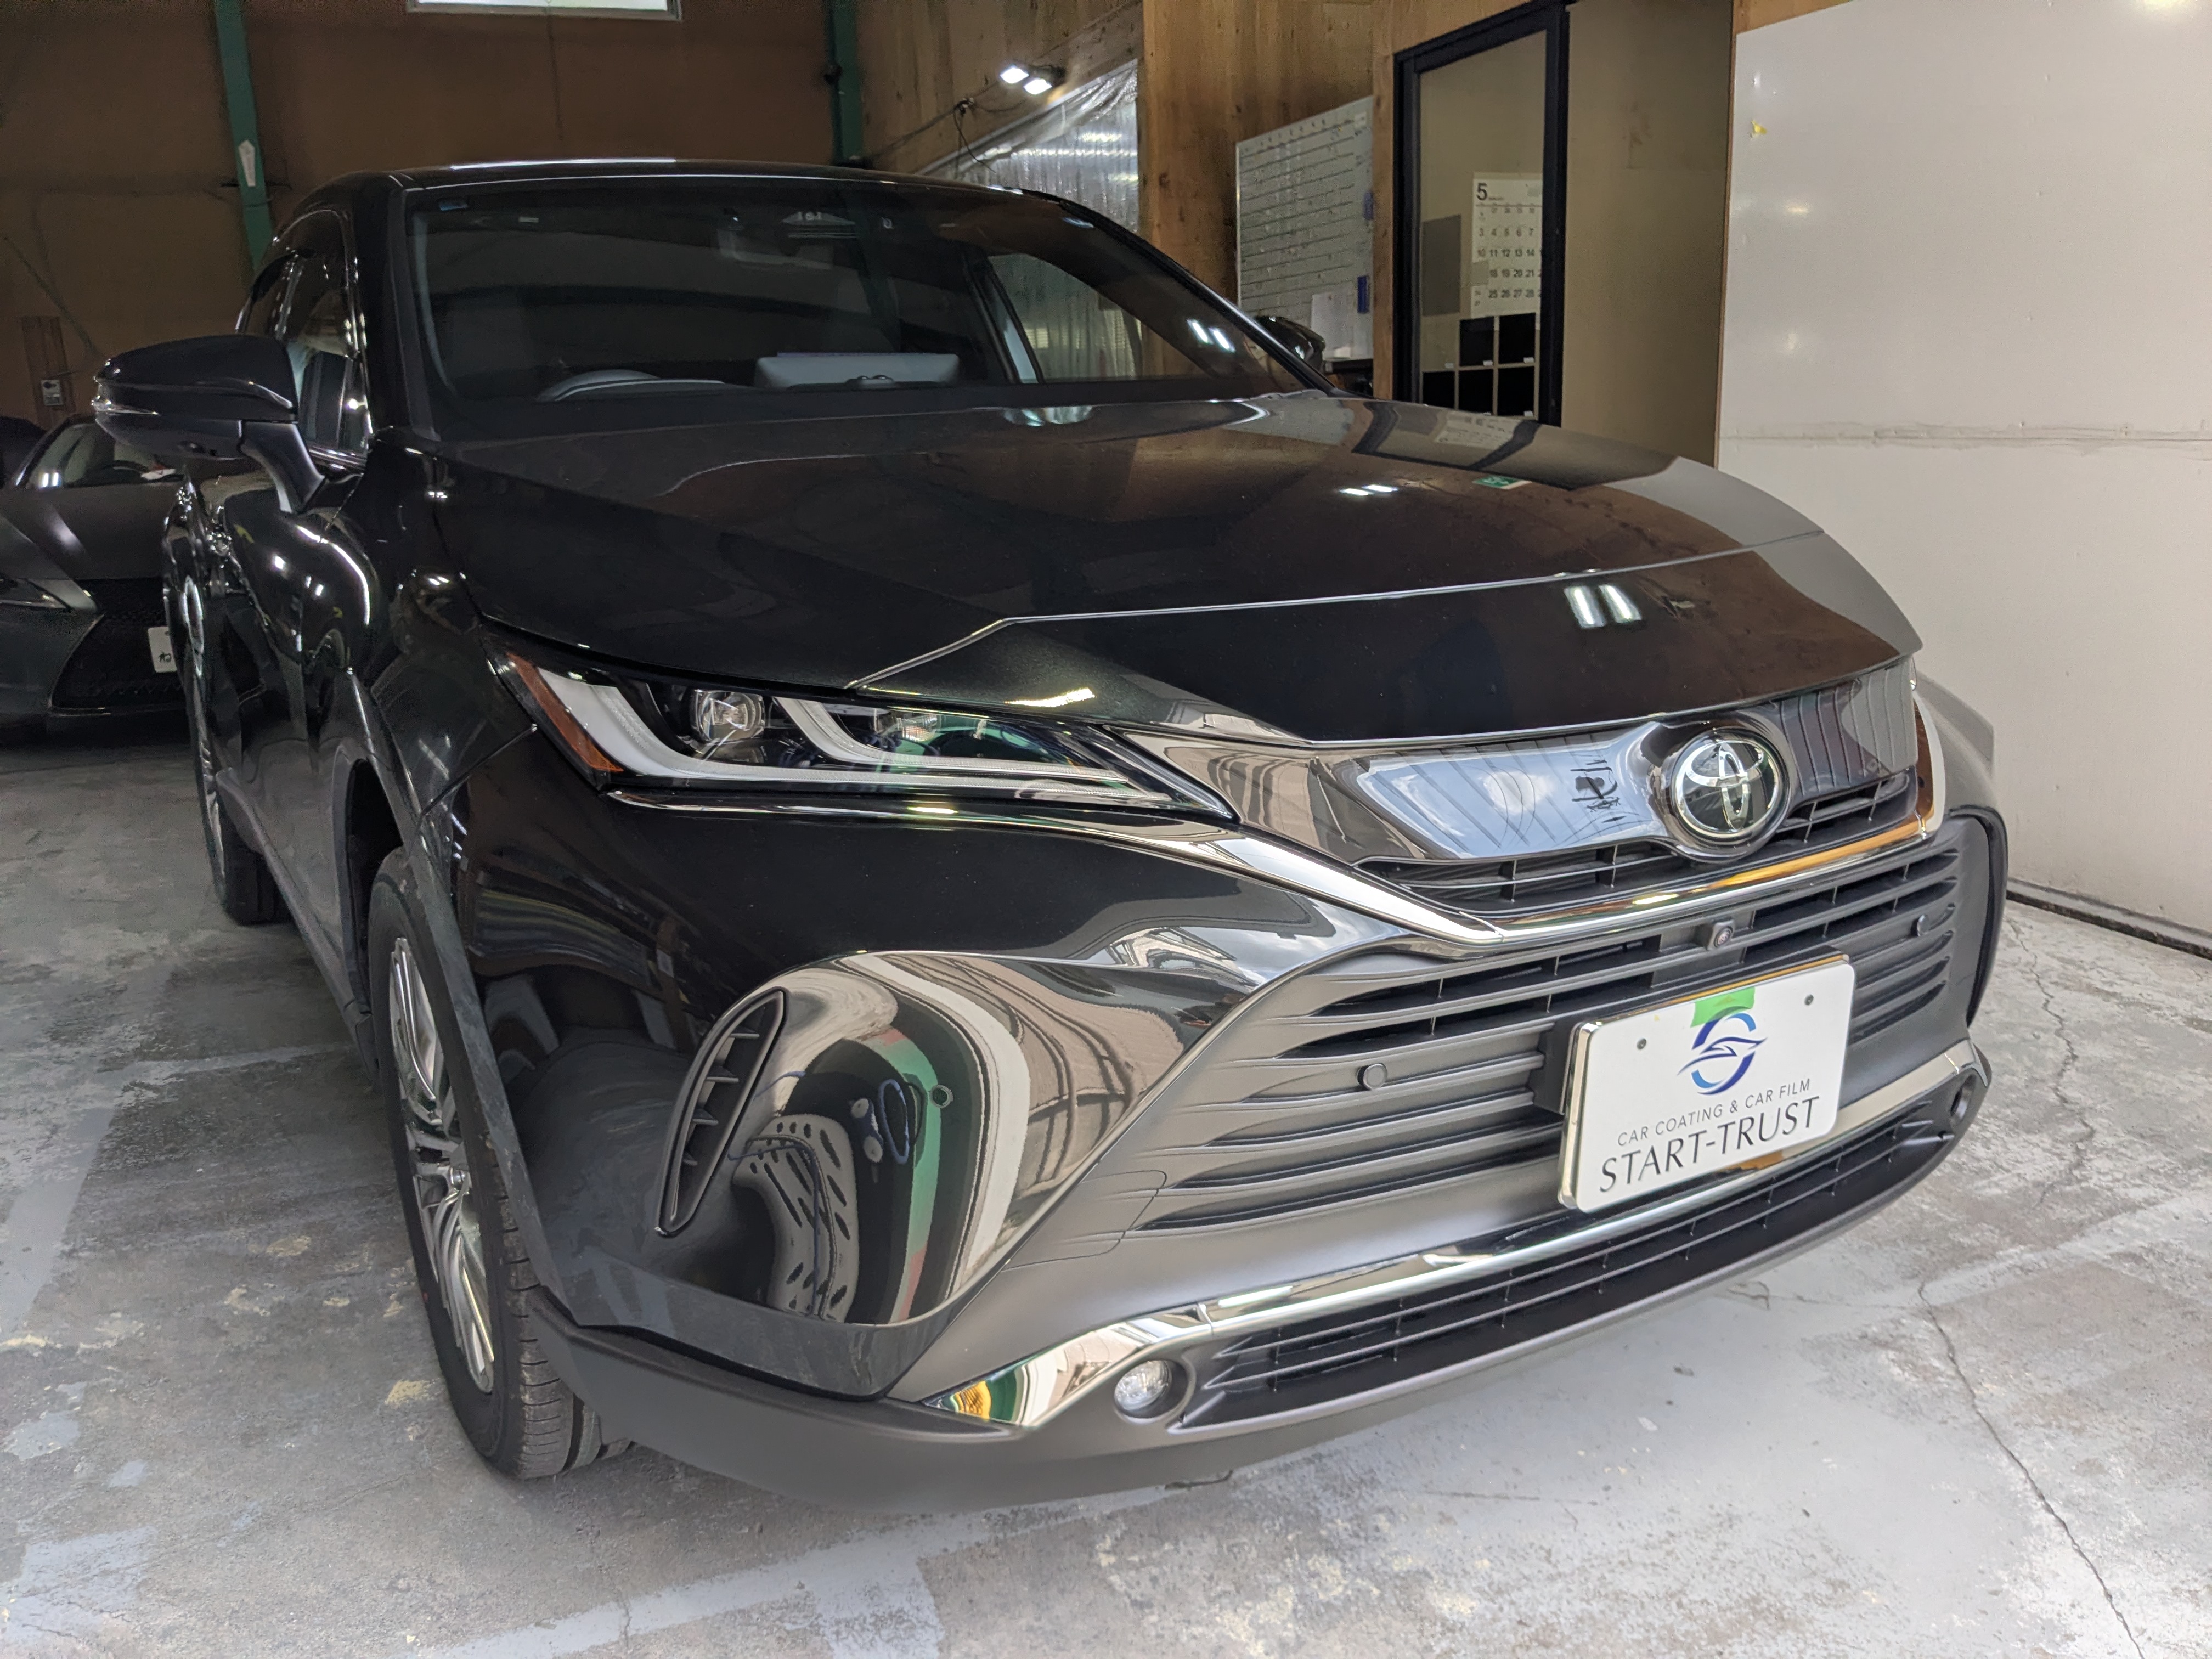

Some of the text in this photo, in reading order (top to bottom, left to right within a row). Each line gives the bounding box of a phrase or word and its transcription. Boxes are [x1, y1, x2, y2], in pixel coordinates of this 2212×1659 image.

[1476, 183, 1487, 201] 5
[1489, 249, 1498, 257] 11
[1525, 269, 1534, 277] 21
[1617, 1077, 1810, 1147] CAR COATING & CAR FILM
[1599, 1096, 1820, 1193] START-TRUST
